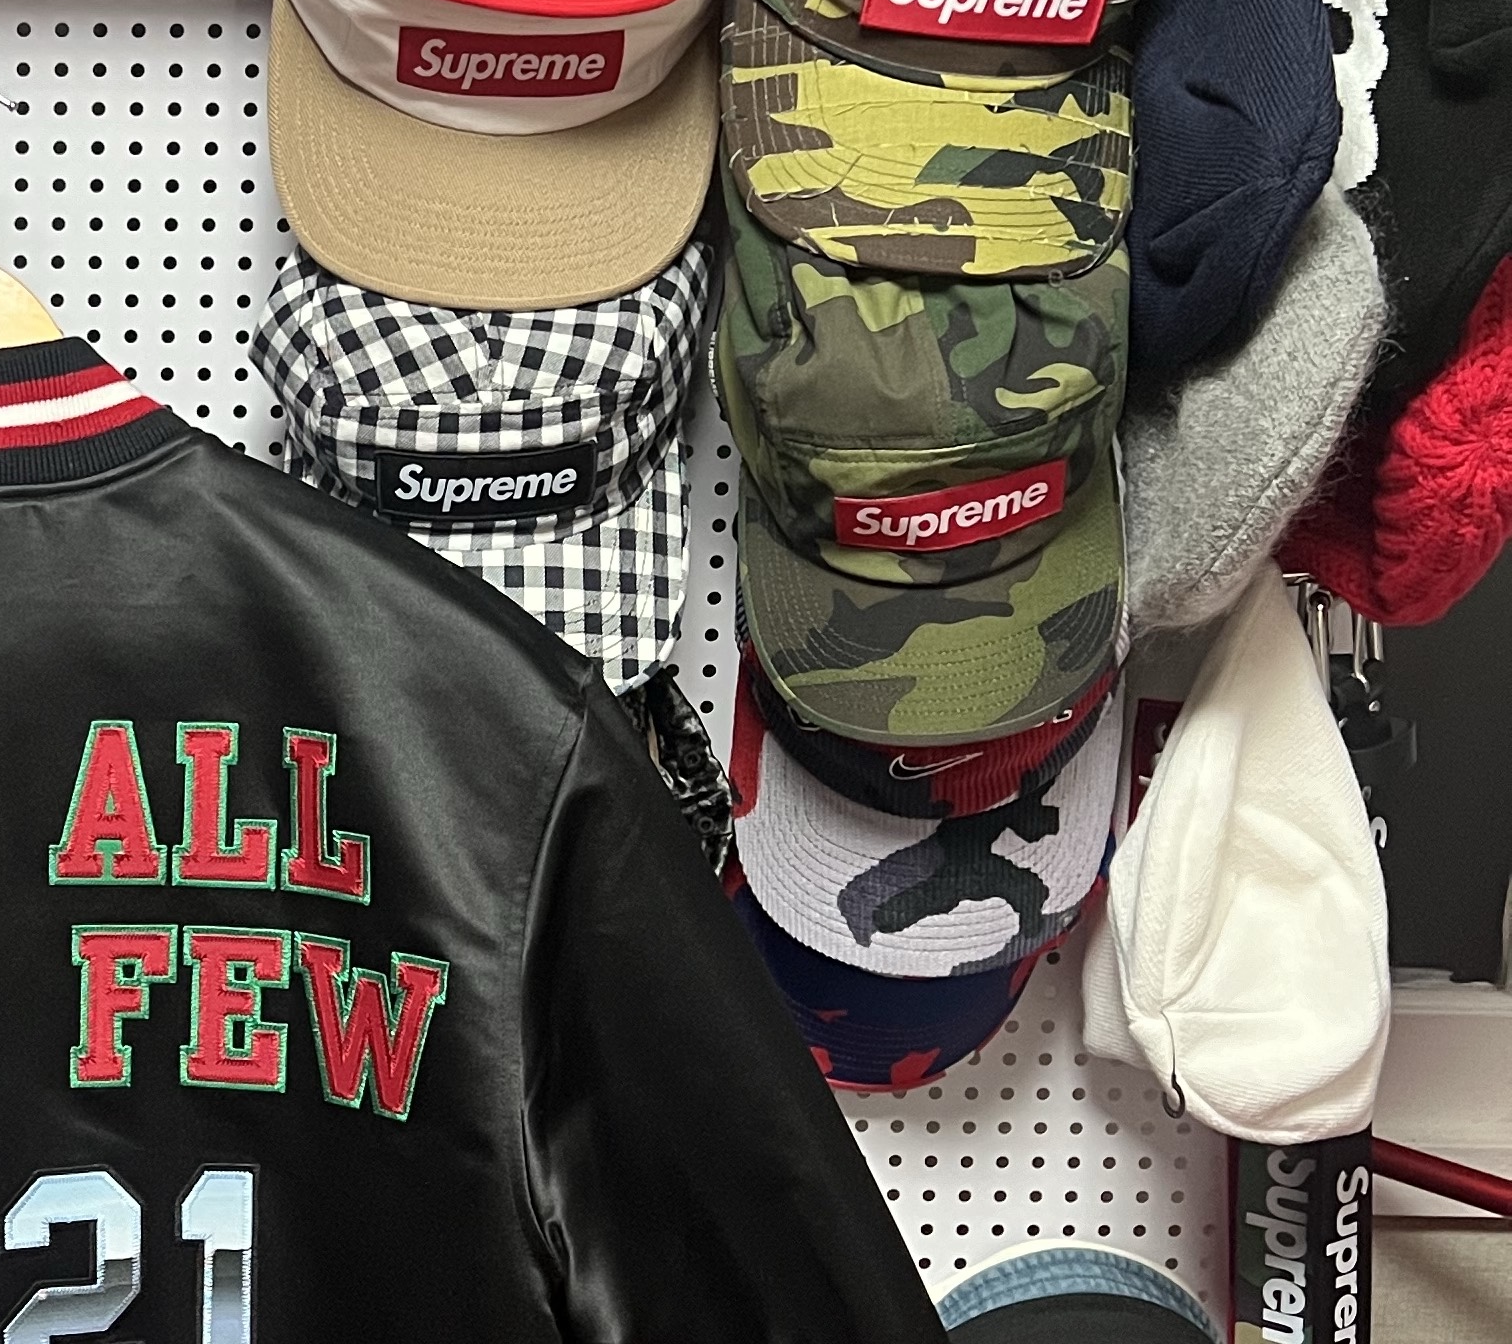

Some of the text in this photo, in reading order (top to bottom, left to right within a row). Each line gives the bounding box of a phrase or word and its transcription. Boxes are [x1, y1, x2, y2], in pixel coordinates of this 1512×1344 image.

[413, 38, 606, 90] Supreme
[395, 462, 578, 513] Supreme
[852, 479, 1049, 545] Supreme
[49, 721, 371, 905] ALL
[70, 924, 450, 1122] FEW
